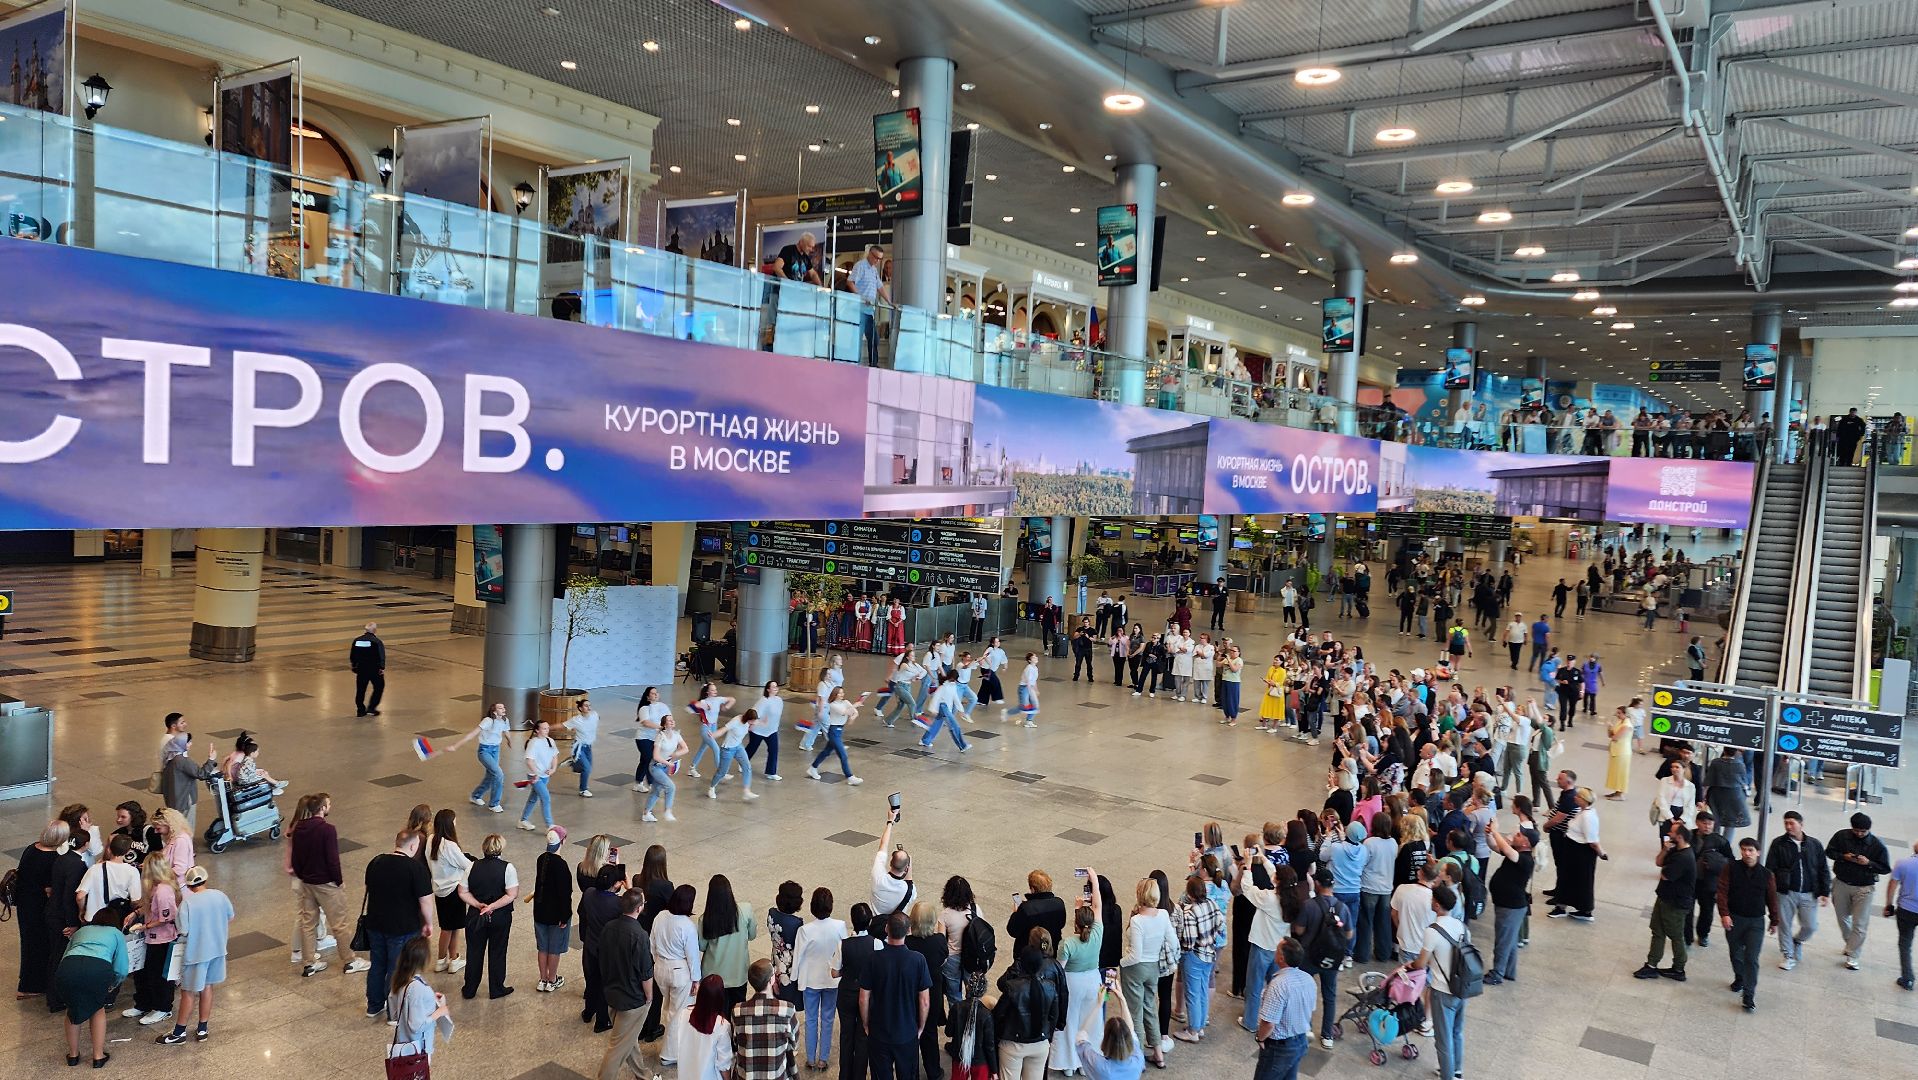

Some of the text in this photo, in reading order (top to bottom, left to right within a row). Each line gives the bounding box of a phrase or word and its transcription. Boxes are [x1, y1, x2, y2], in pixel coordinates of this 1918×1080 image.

[605, 404, 840, 446] КУРОРТНАЯ ЖИЗНЬ
[670, 445, 791, 474] В МОСКВЕ
[1217, 455, 1283, 473] КУРОРТНАЯ ЖИЗНЬ
[1232, 474, 1268, 489] В МОСКВЕ
[1291, 453, 1372, 495] ОСТРОВ.
[1648, 499, 1708, 514] ДОНСТРОЙ
[960, 576, 979, 584] ТУАЛЕТ
[1699, 697, 1730, 707] ВЫЛЕТ
[1831, 714, 1868, 724] АПТЕКА
[1697, 724, 1731, 735] ТУАЛЕТ
